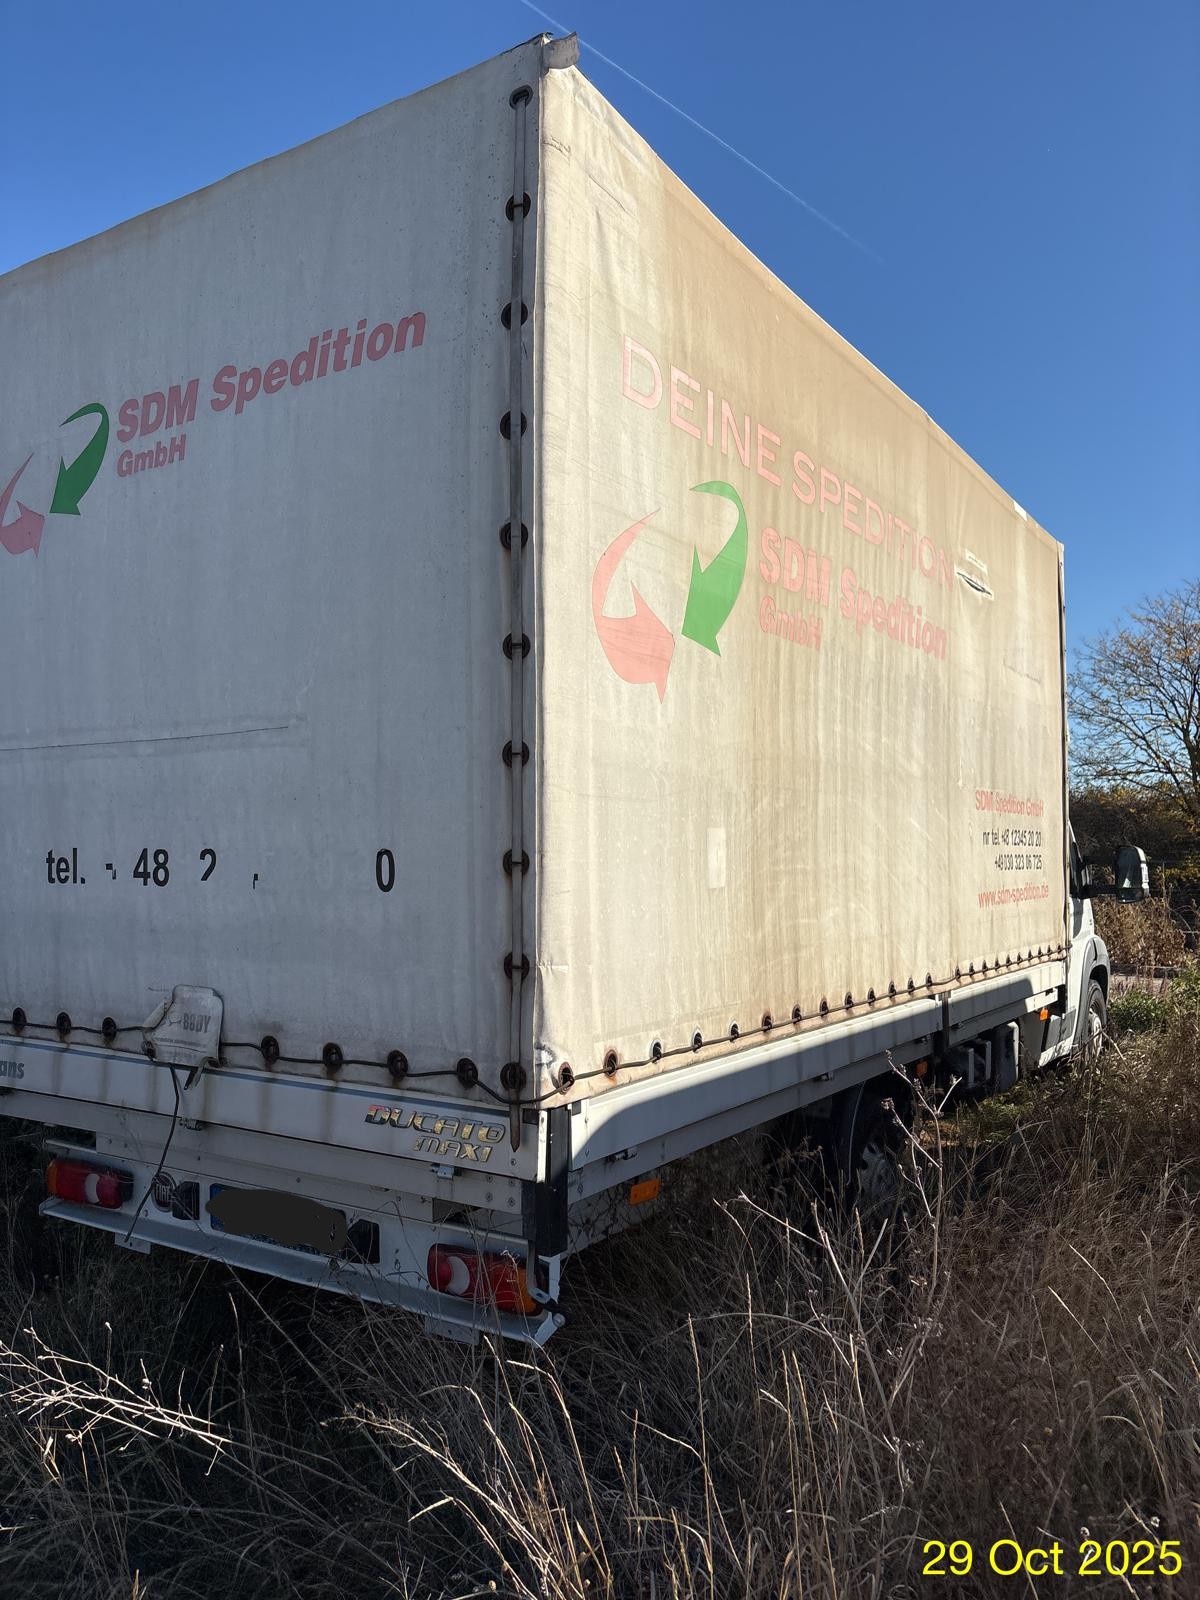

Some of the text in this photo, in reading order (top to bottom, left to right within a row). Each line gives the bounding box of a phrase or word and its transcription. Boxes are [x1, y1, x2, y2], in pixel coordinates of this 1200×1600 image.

[116, 311, 427, 443] SDM Spedition
[116, 434, 187, 479] GmbH
[622, 334, 955, 594] DEINE SPEDITION
[759, 527, 947, 660] SDM Spedition
[759, 595, 825, 652] GmbH
[975, 790, 1044, 817] SDM Spedition GmbH
[1011, 829, 1027, 846] 12345
[1027, 830, 1035, 847] 20
[1035, 831, 1042, 847] 20
[46, 847, 86, 885] tel.
[133, 847, 170, 887] 48
[375, 848, 396, 893] 0
[978, 882, 1049, 908] www.sdm-spedition.de
[365, 1104, 506, 1144] DUCATO
[413, 1135, 493, 1163] MAXI
